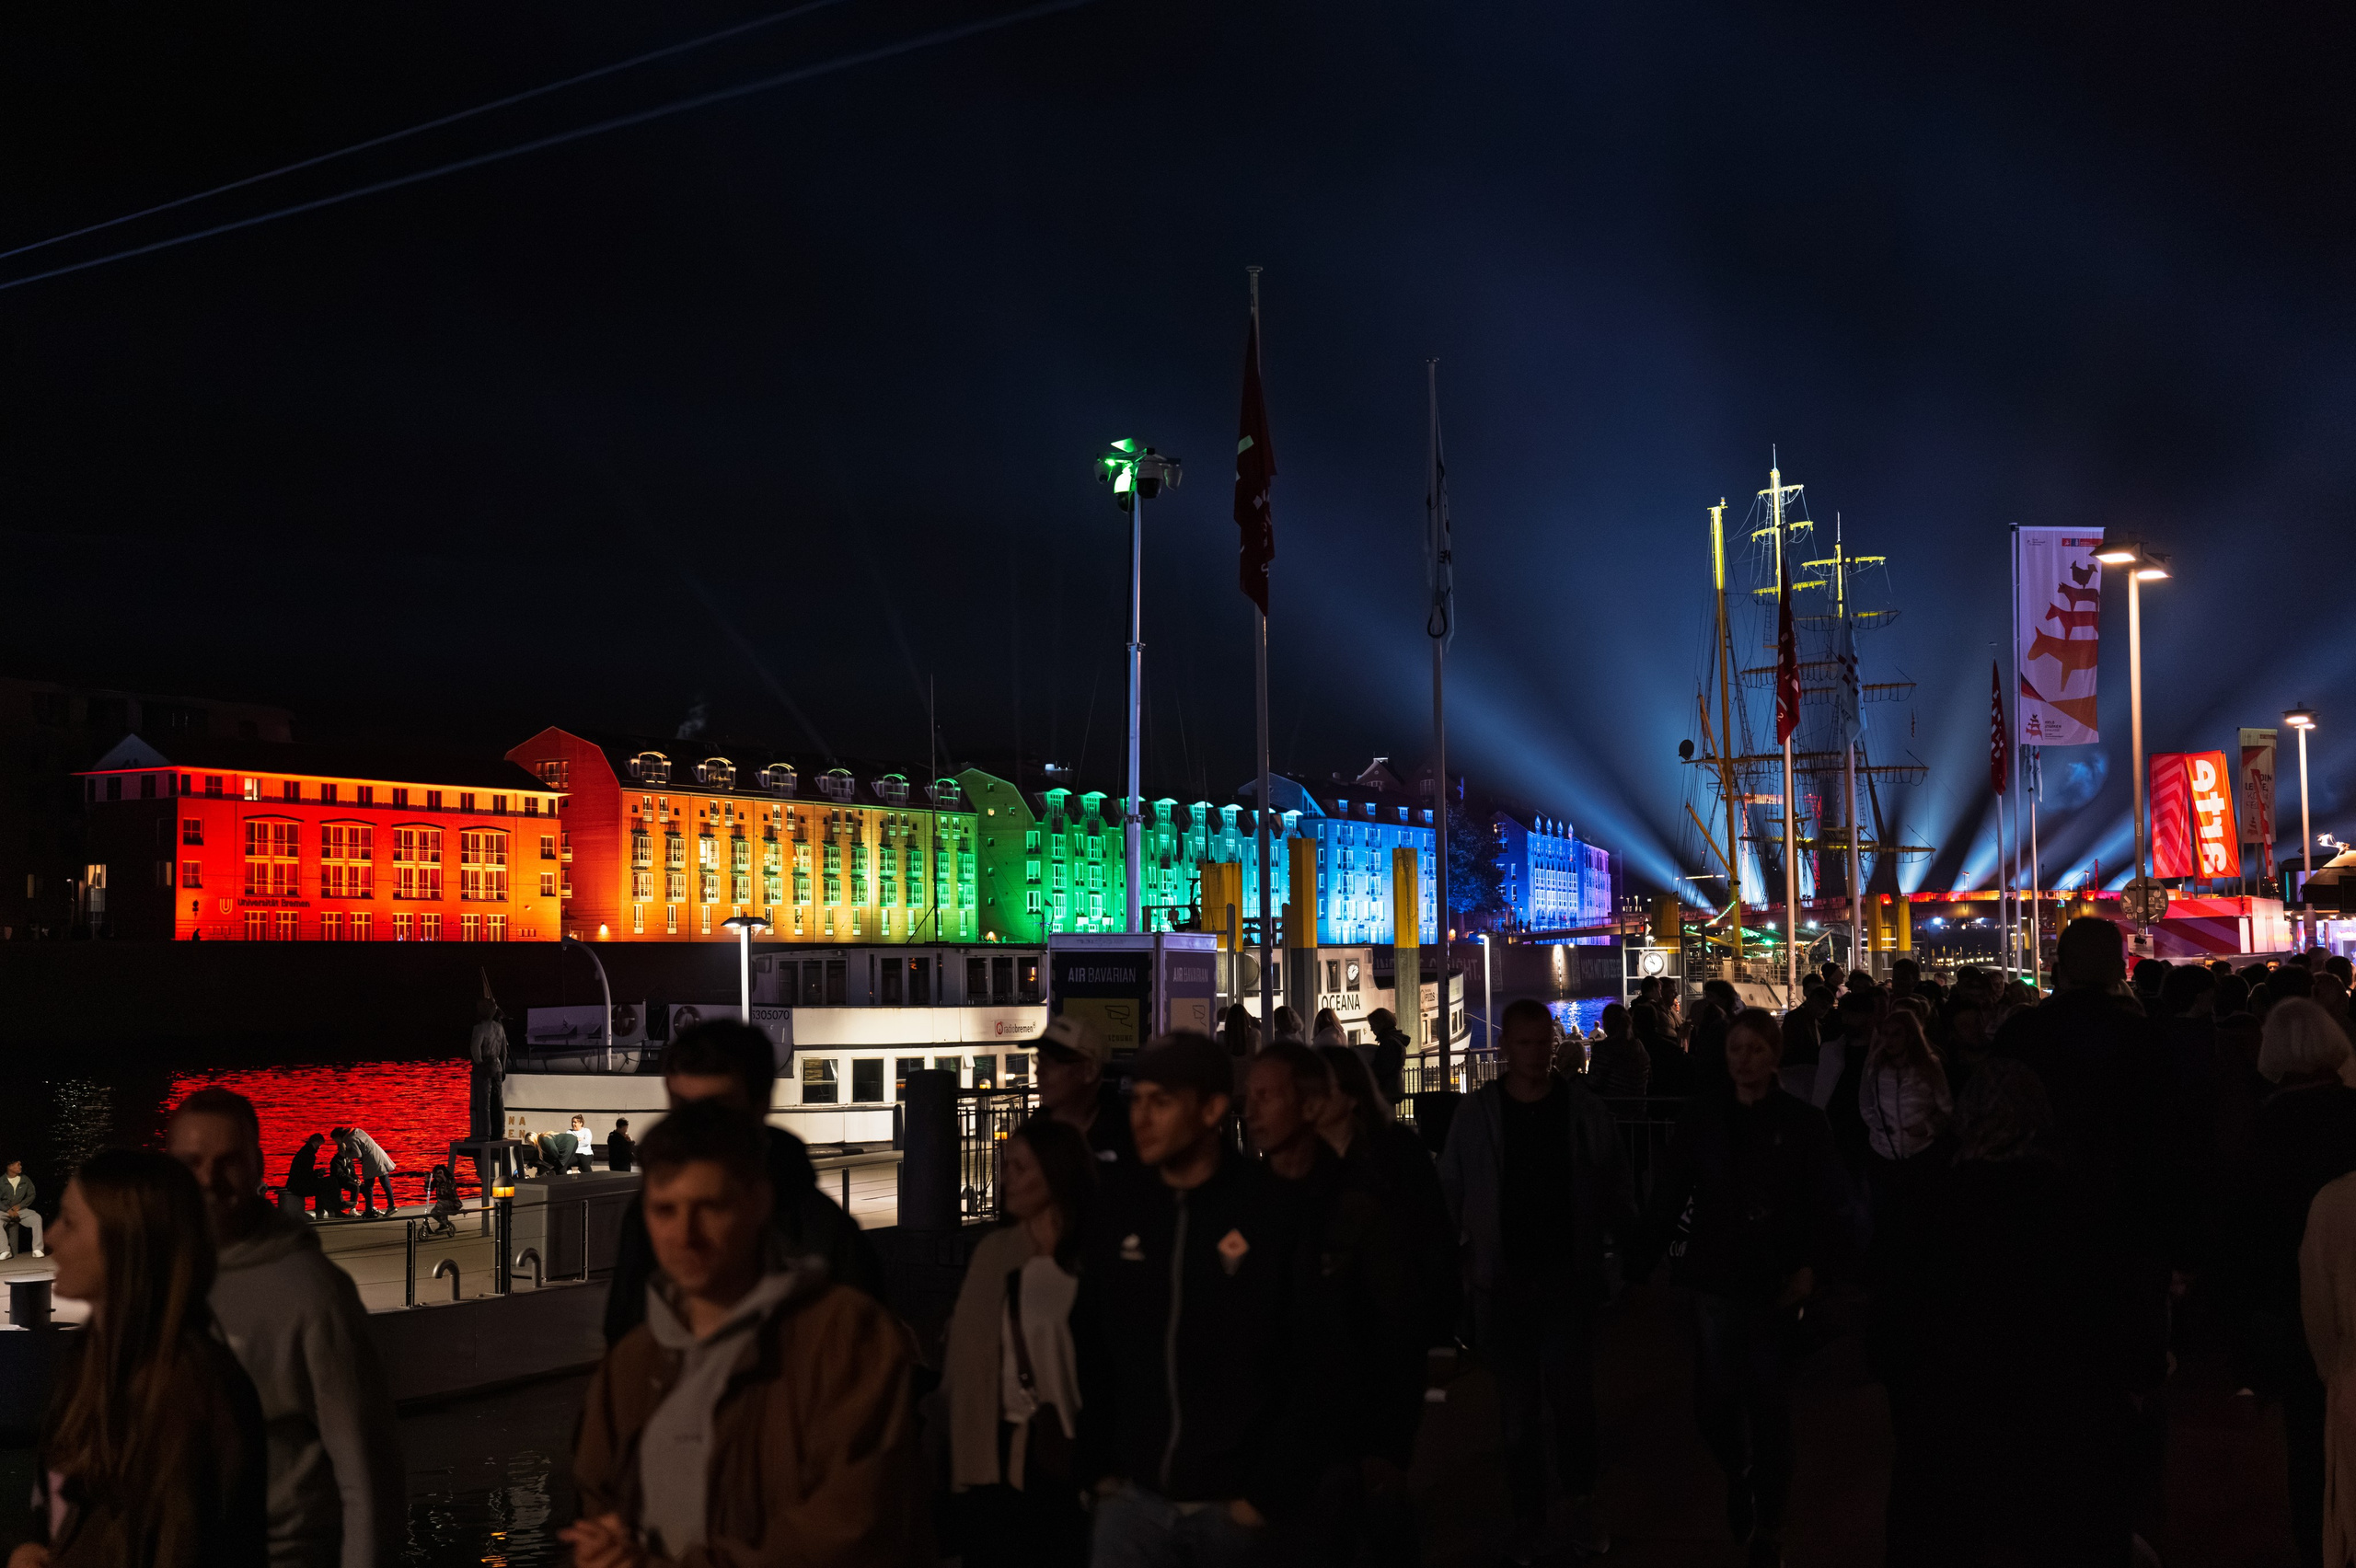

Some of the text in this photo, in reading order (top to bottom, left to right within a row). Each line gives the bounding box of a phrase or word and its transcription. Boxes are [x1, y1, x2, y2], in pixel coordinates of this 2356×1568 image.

[281, 899, 310, 908] Bremen
[1068, 967, 1137, 983] AIR BAVARIAN
[1172, 966, 1184, 983] AIR
[1322, 994, 1361, 1011] OCEANA
